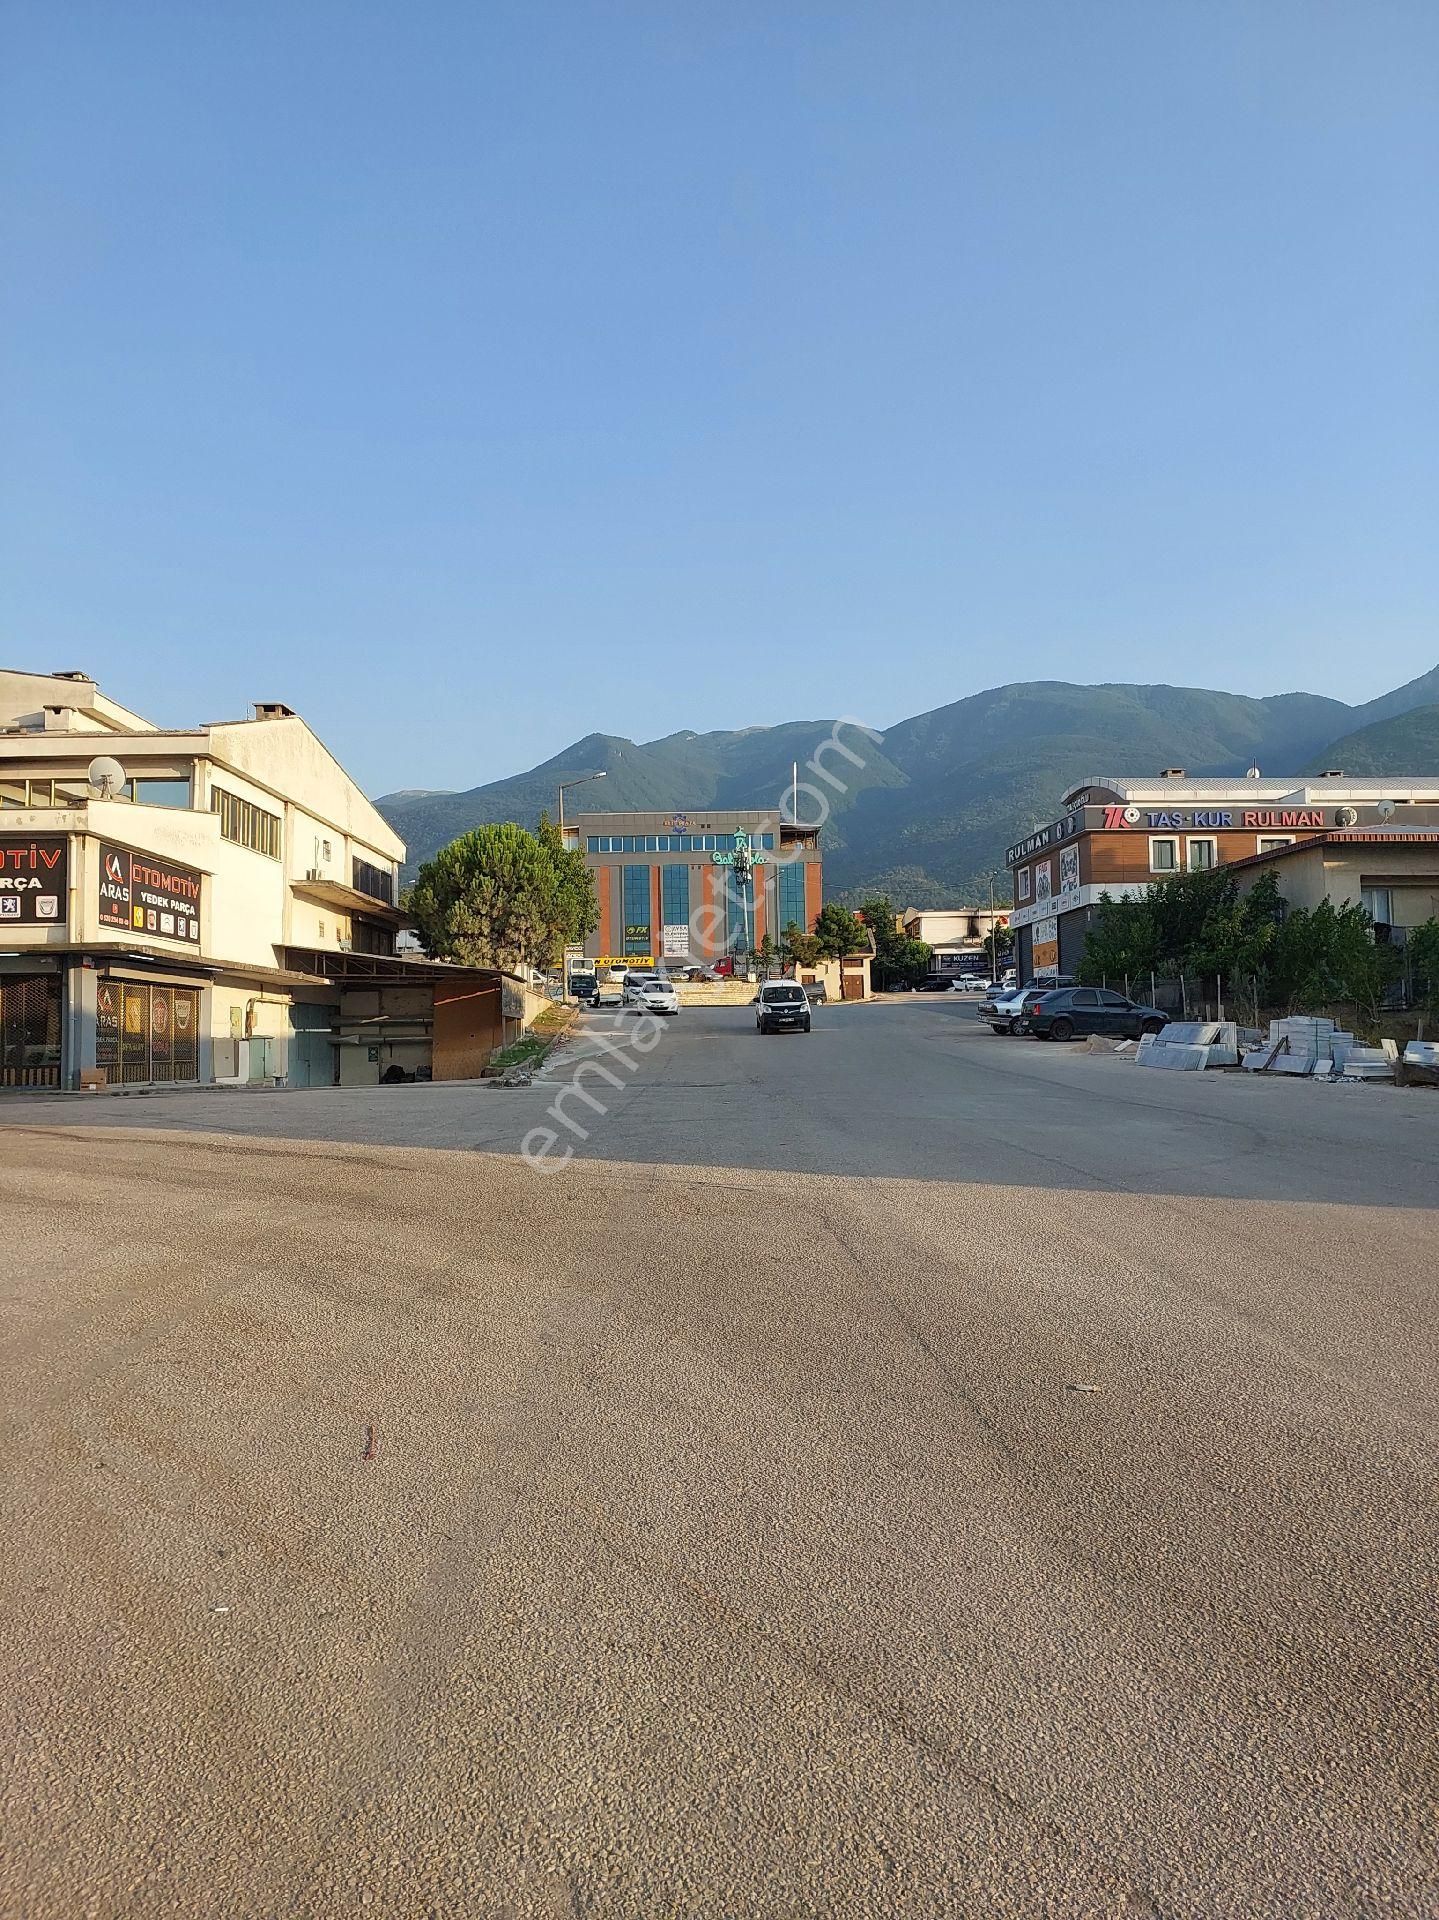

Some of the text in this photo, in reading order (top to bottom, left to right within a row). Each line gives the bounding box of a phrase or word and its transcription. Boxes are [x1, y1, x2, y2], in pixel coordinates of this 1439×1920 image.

[1243, 811, 1324, 826] RULMAN
[1008, 830, 1049, 863] RULMAN
[100, 882, 130, 902] ARAS
[132, 863, 200, 899] OTOMOTİV
[140, 891, 196, 916] YEDEK PARÇA
[635, 926, 648, 934] FX
